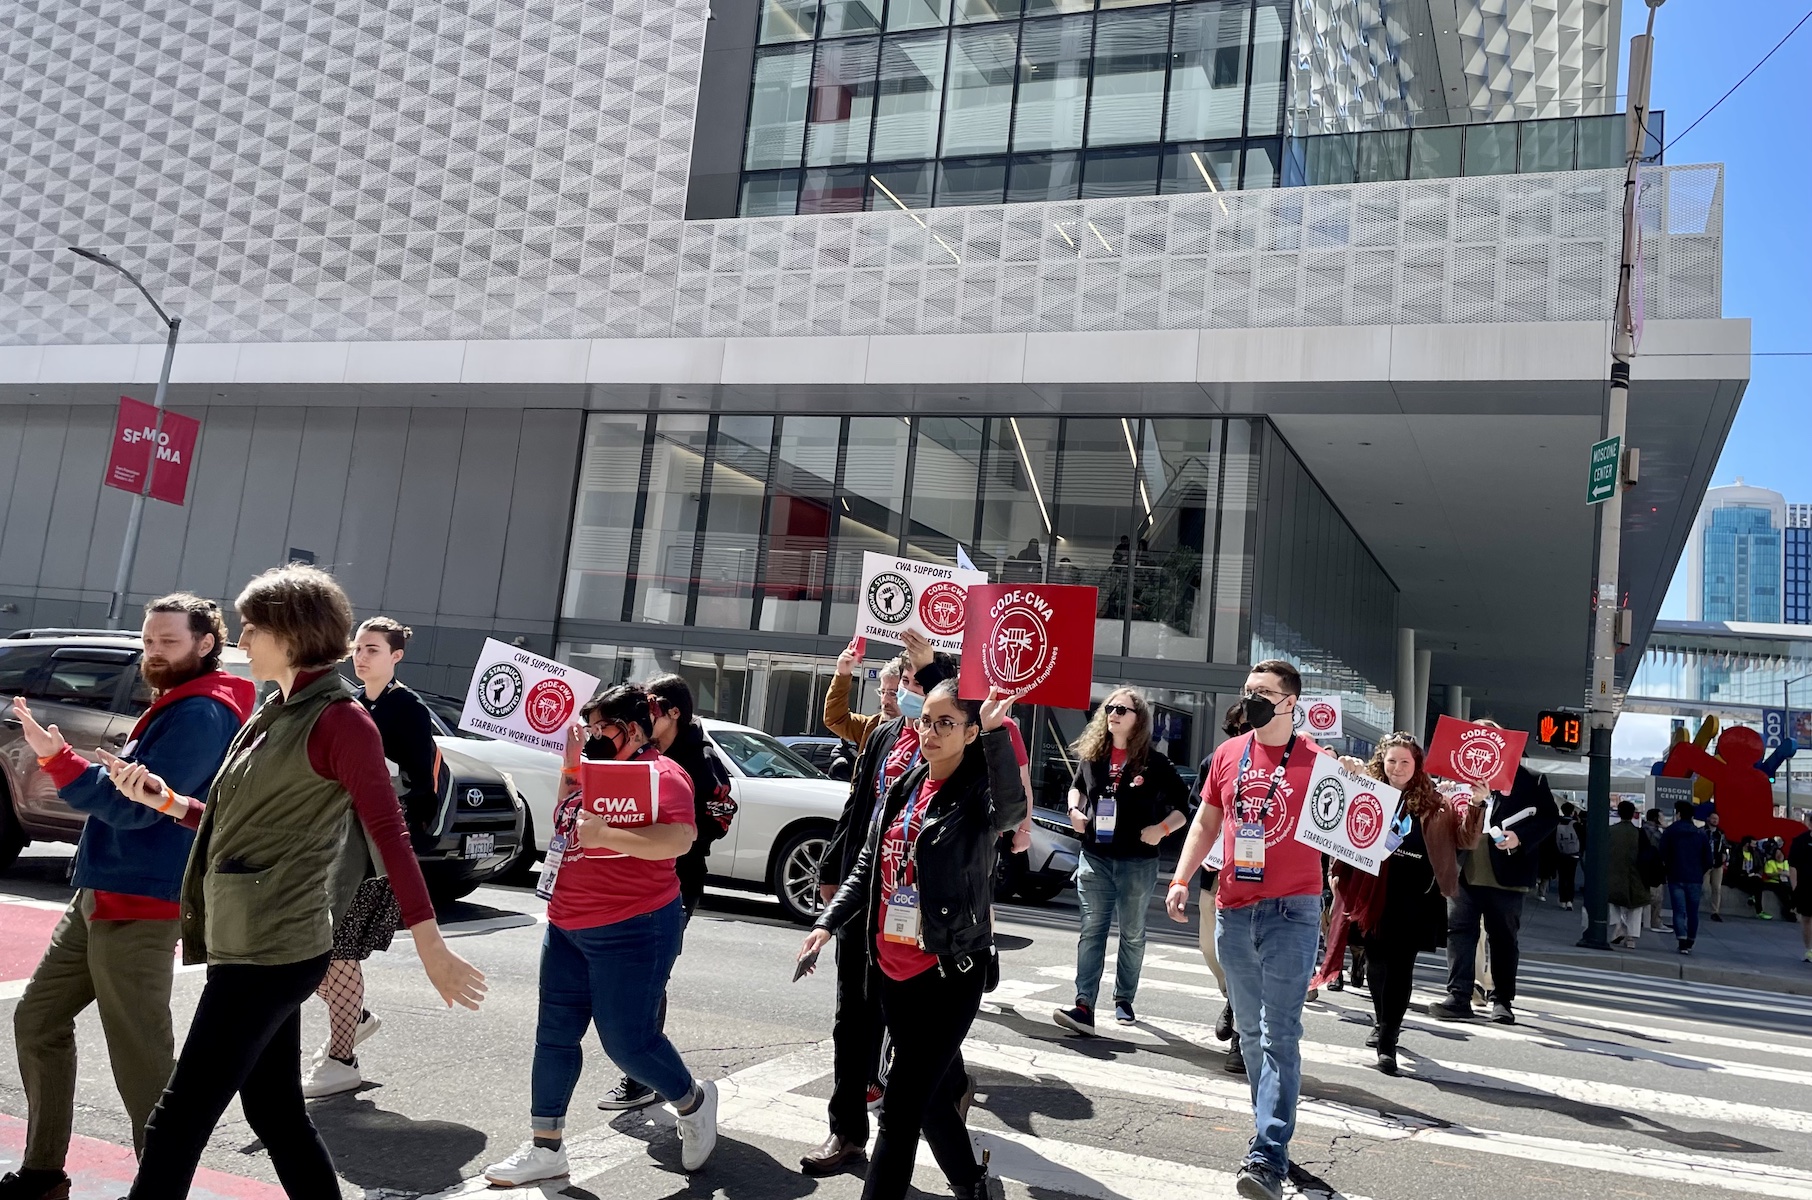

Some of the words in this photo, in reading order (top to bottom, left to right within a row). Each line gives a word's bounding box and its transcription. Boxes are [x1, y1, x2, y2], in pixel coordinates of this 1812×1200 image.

[1593, 442, 1618, 463] MOSCONE
[1593, 464, 1613, 483] CENTER
[895, 561, 912, 573] CWA
[913, 564, 953, 579] SUPPORTS
[874, 575, 910, 595] STARBUCKS
[926, 583, 968, 602] CODE-CWA
[868, 593, 889, 621] WORKERS
[894, 601, 912, 621] UNITED
[989, 590, 1054, 623] CODE-CWA
[942, 640, 963, 651] UNITE
[513, 652, 531, 665] CWA
[530, 657, 568, 678] SUPPORTS
[982, 642, 992, 679] Campaign
[1015, 680, 1039, 696] Digital
[1035, 646, 1059, 685] Employees
[488, 665, 522, 687] STARBUCKS
[479, 683, 497, 715] WORKERS
[536, 680, 573, 702] CODE-CWA
[500, 694, 520, 715] UNITED
[470, 717, 508, 736] STARBUCKS
[508, 729, 541, 746] WORKERS
[541, 738, 565, 752] UNITED
[1460, 729, 1507, 750] CODE-CWA
[1564, 720, 1580, 744] 13
[1766, 712, 1782, 747] GDC
[1319, 778, 1345, 801] STARBUCKS
[1337, 766, 1349, 779] CWA
[1348, 772, 1377, 792] SUPPORTS
[1656, 786, 1692, 795] MOSCONE
[1660, 793, 1688, 801] CENTER
[593, 797, 638, 813] CWA
[1311, 797, 1325, 828] WORKERS
[1353, 794, 1382, 817] CODE-CWA
[1240, 828, 1261, 838] GDC
[551, 840, 564, 852] GDC
[1302, 830, 1334, 850] STARBUCKS
[1332, 841, 1356, 860] WORKERS
[1354, 853, 1375, 869] UNITED
[893, 893, 916, 906] GDC
